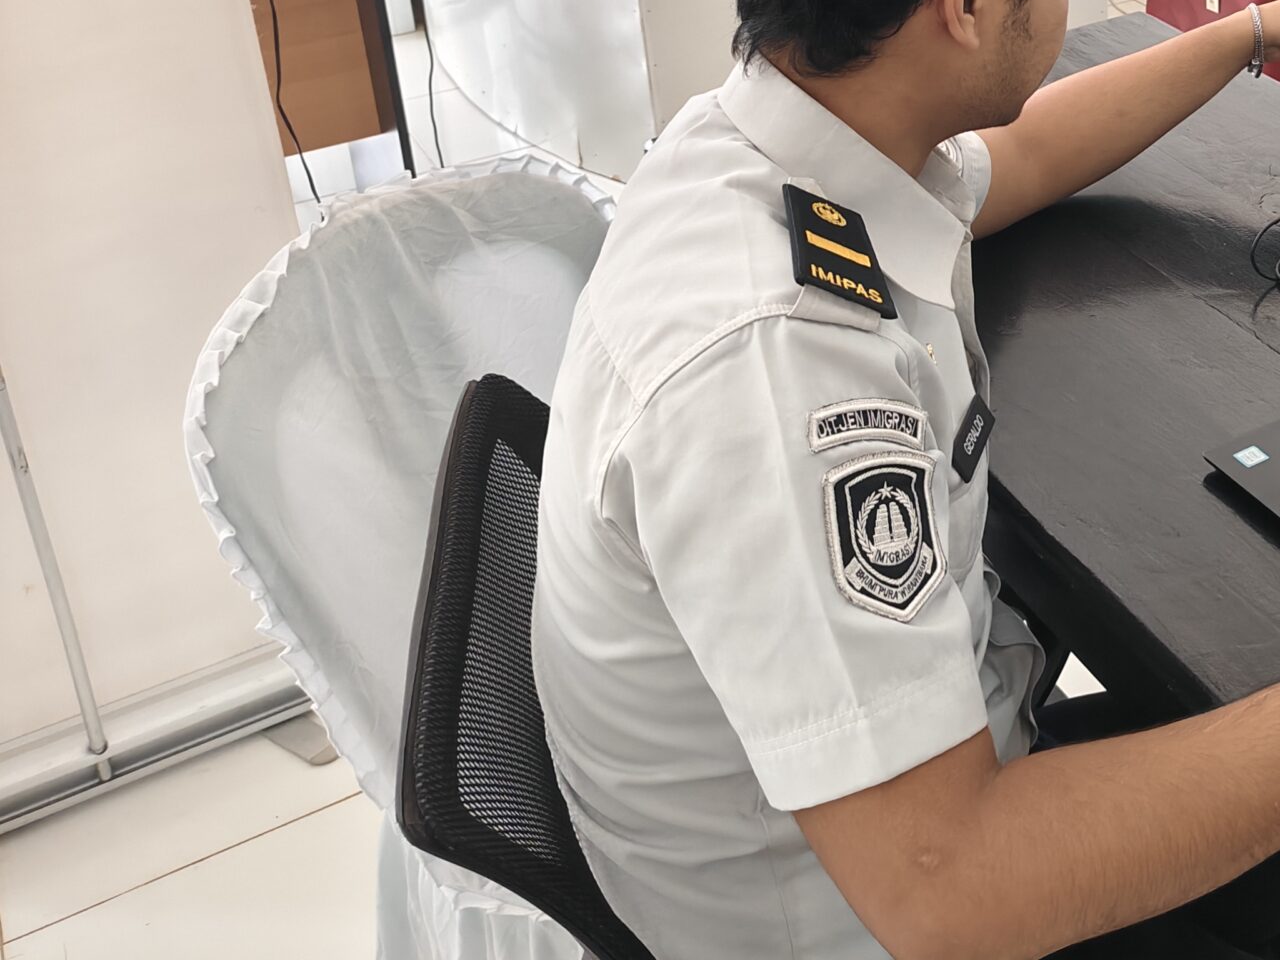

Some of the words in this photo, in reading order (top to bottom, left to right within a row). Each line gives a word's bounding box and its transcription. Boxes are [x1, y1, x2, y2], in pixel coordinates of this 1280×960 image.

[810, 263, 883, 304] IMIPAS
[818, 409, 864, 438] DITJEN
[867, 408, 916, 436] IMIGRASI
[963, 414, 984, 455] GERALDO
[874, 542, 913, 564] IMIGRASI
[878, 585, 899, 600] PURA
